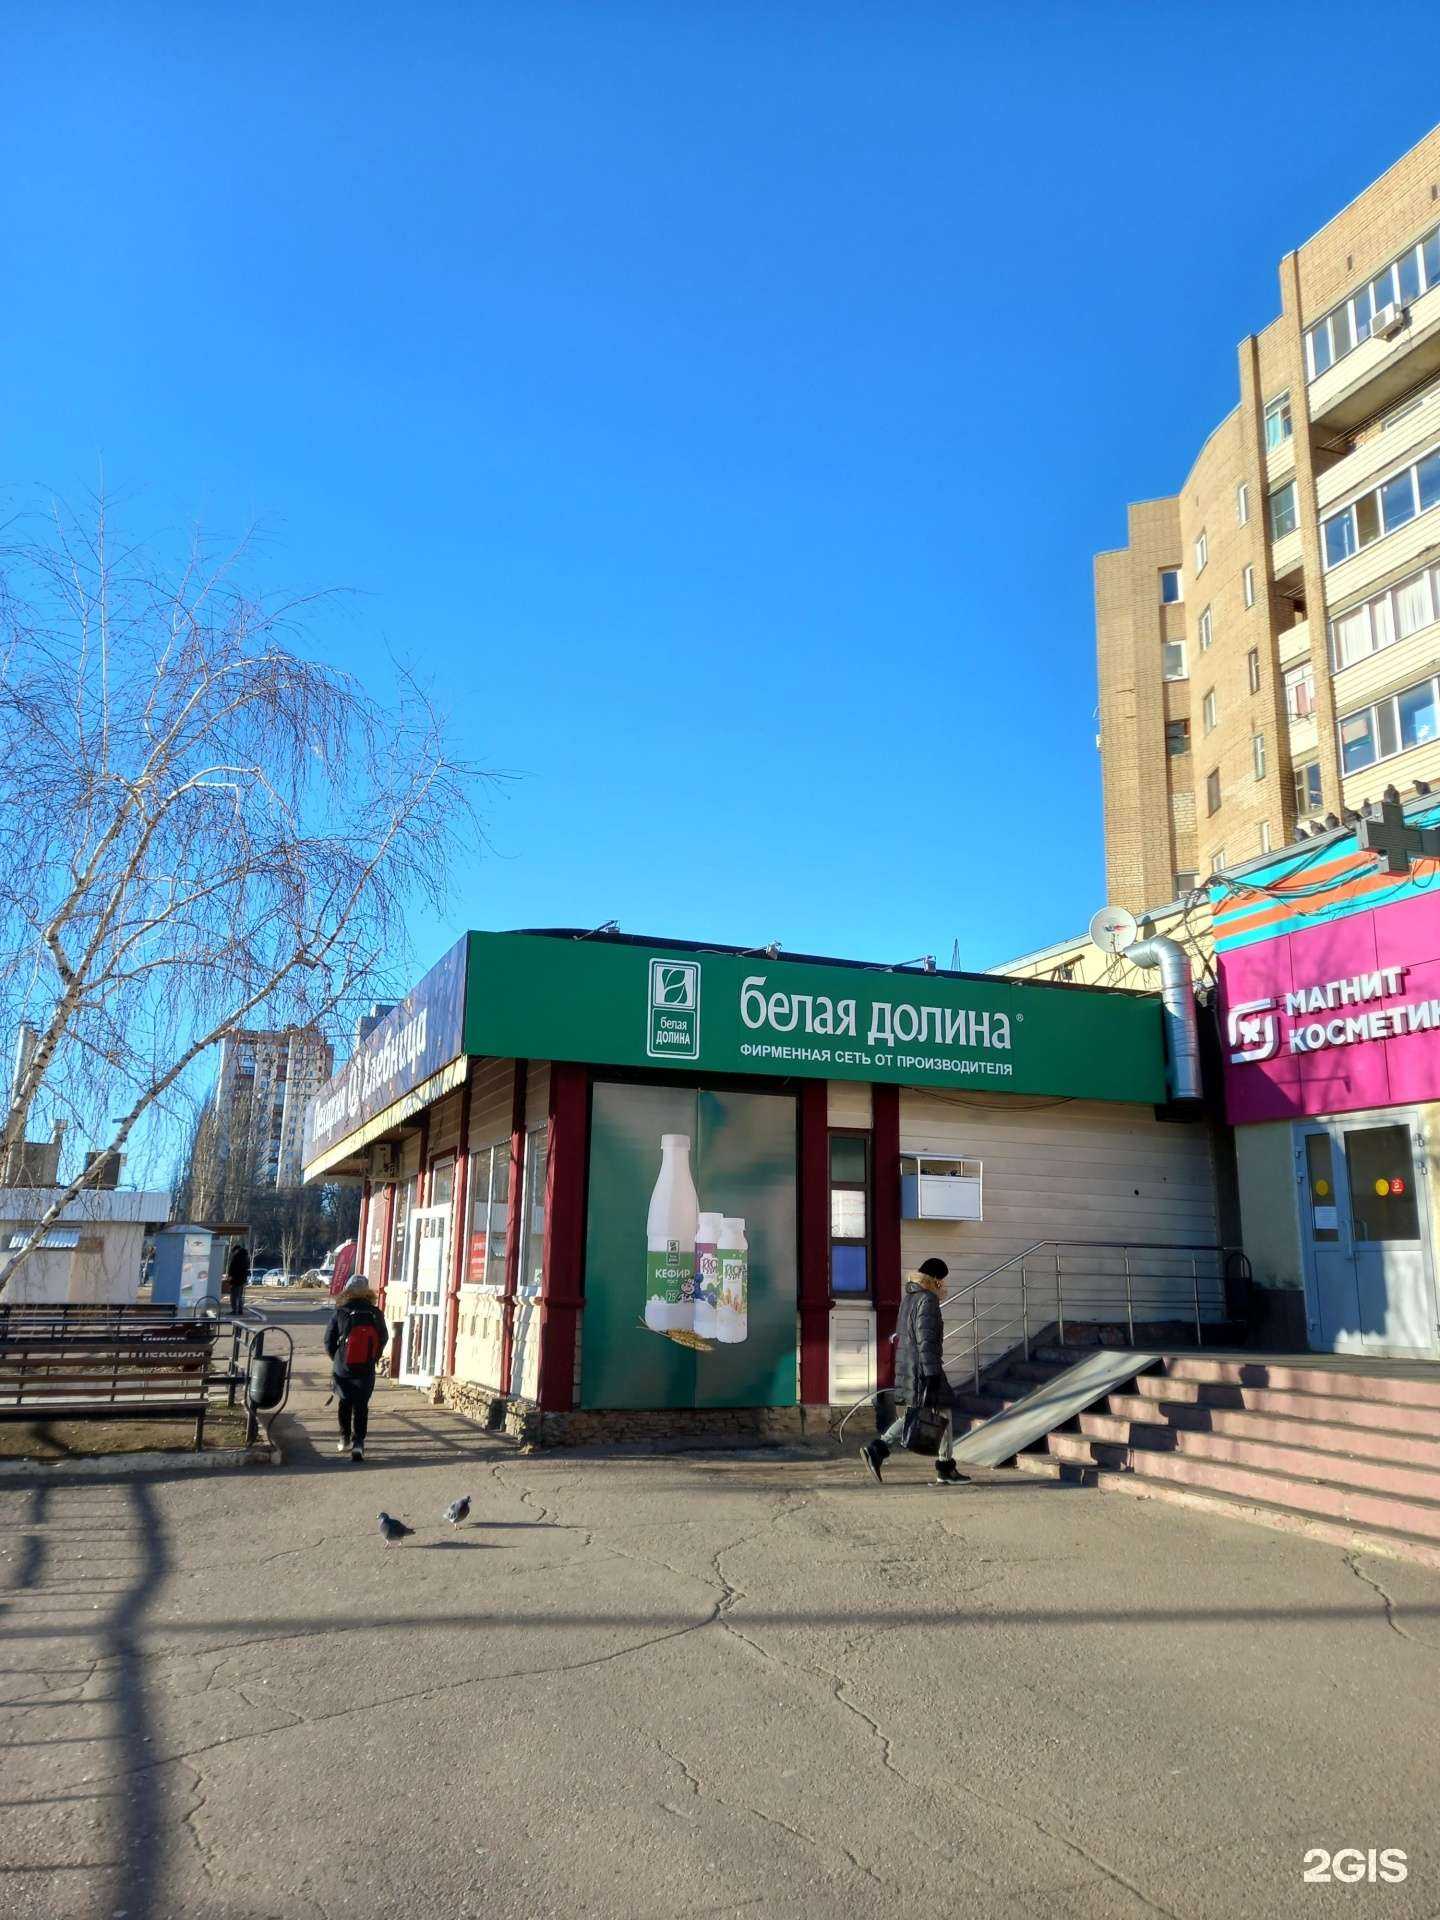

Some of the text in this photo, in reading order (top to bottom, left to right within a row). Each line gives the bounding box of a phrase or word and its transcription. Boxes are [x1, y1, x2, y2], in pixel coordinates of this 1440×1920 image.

[1285, 967, 1405, 1015] МАГНИТ
[660, 1016, 687, 1031] белая
[740, 976, 1012, 1049] белая долина
[656, 1030, 691, 1045] ДОЛИНА
[740, 1045, 1013, 1076] ФИРМЕННАЯ СЕТЬ ОТ ПРОИЗВОДИТЕЛЯ
[655, 1269, 690, 1279] КЕФИР
